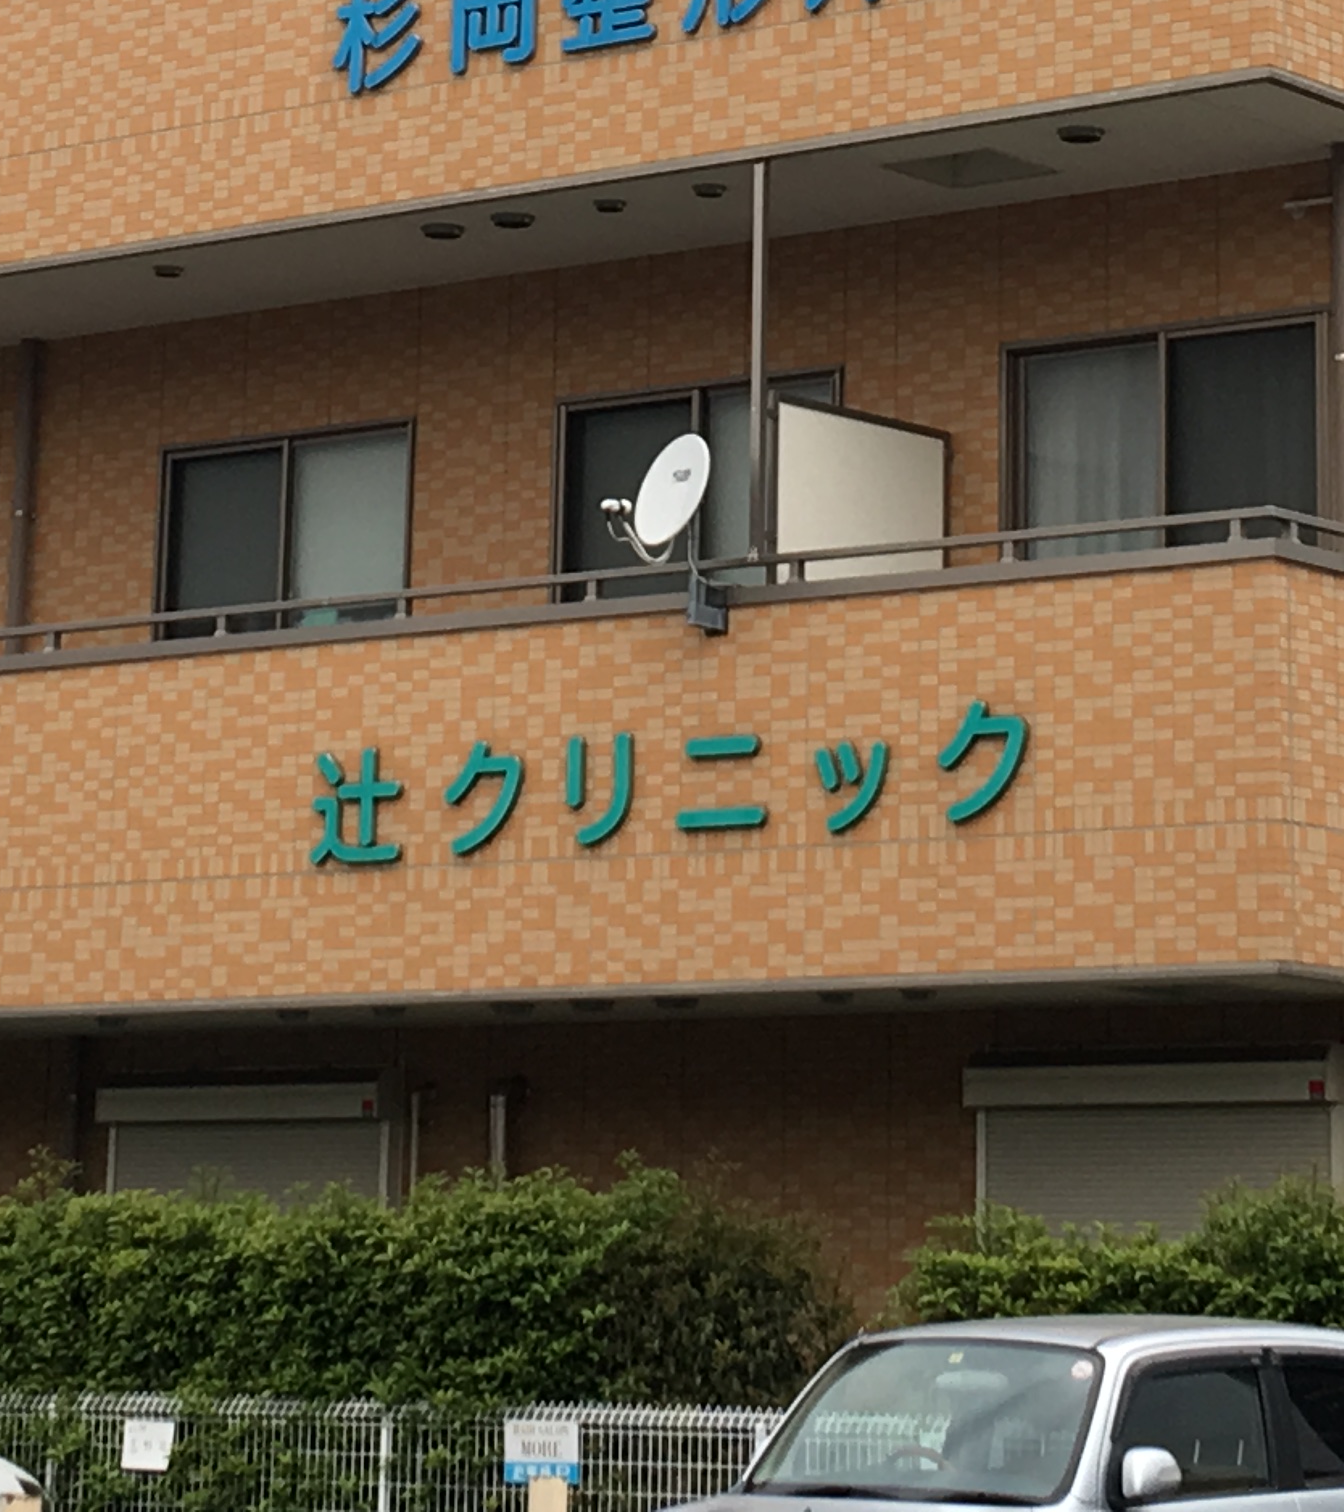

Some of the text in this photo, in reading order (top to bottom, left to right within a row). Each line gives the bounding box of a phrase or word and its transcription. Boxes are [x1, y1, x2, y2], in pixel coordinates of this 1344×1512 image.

[308, 699, 1029, 867] 辻クリニック
[521, 1440, 563, 1458] MORE
